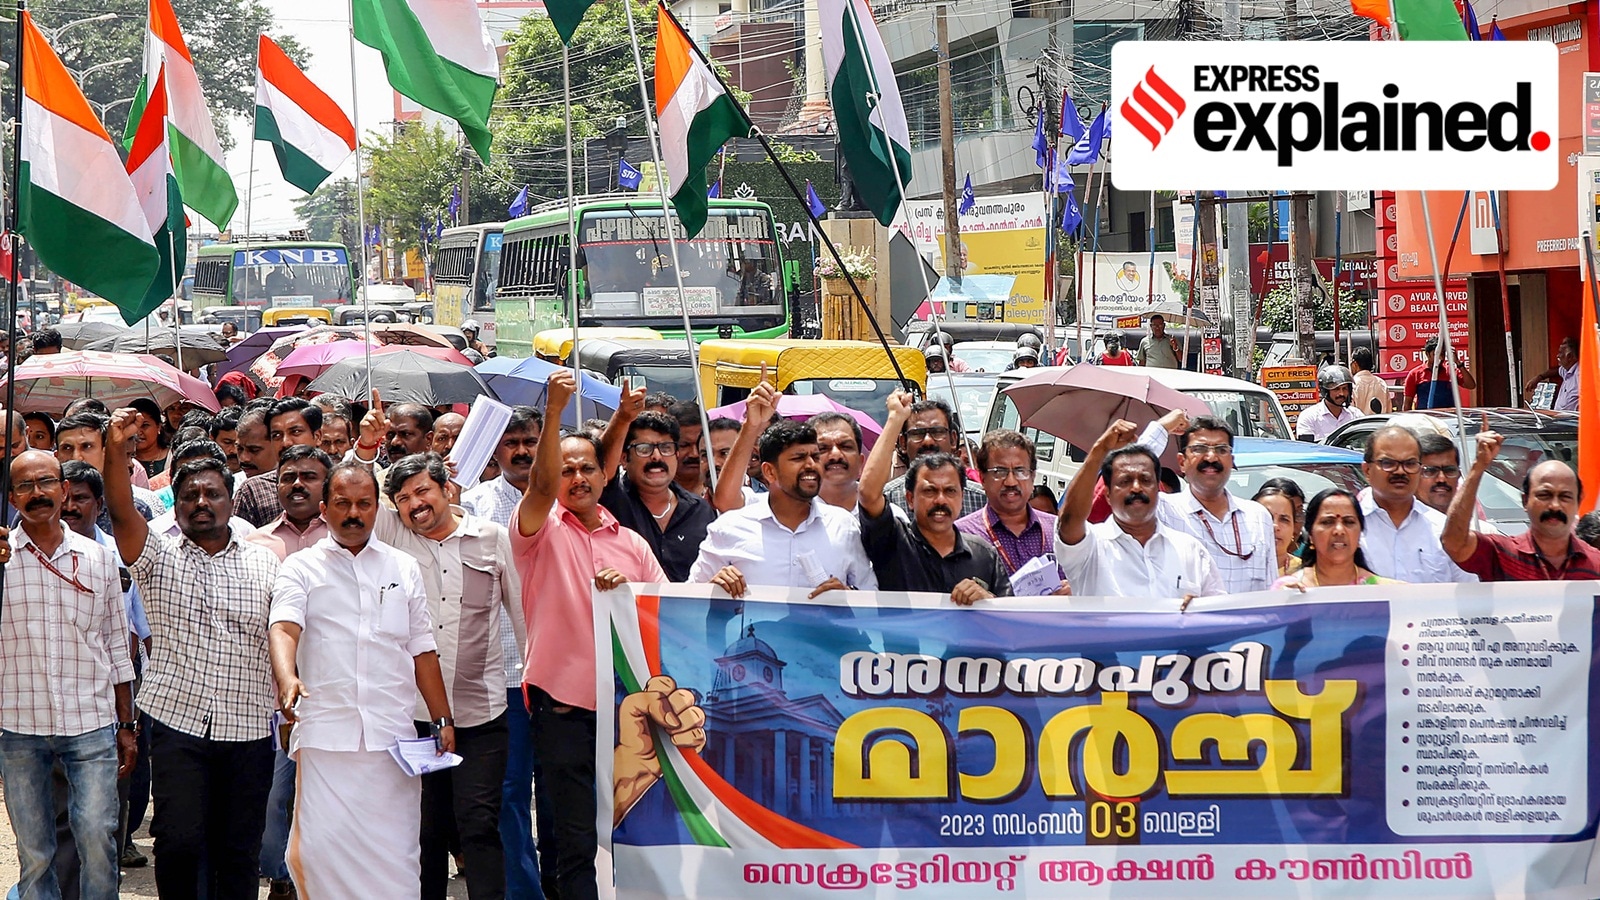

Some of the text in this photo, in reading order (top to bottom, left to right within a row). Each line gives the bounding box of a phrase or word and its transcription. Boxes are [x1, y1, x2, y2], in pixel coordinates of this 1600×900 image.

[621, 169, 637, 179] STU
[1536, 239, 1566, 253] PREFERRED
[243, 249, 339, 265] KNB
[1410, 292, 1431, 301] AYUR
[1410, 304, 1440, 312] BEAUT
[1417, 639, 1580, 654] ആറു ഗഡു ഡി എ അനുവദിക്കുക.
[1417, 654, 1552, 669] ലീവ് സറണ്ടർ തുക പണമായി
[839, 641, 1266, 704] അനന്തപുരി
[1417, 671, 1465, 684] നൽകുക.
[1417, 701, 1486, 714] നടപ്പിലാക്കുക.
[1469, 717, 1517, 729] പെൻഷൻ
[1519, 715, 1568, 731] പിൻവലിച്ച്
[832, 679, 1358, 800] മാർച്ച്
[1462, 733, 1509, 745] പെൻഷൻ
[1417, 747, 1480, 760] സ്ഥാപിക്കുക.
[1484, 761, 1549, 775] തസ്തികകൾ
[1417, 777, 1490, 792] സംരക്ഷിക്കുക.
[940, 801, 1221, 840] 2023 നവംബർ 03 വെള്ളി
[742, 850, 1473, 891] സെക്രട്ടേറിയറ്റ് ആക്ഷൻ കൗൺസിൽ
